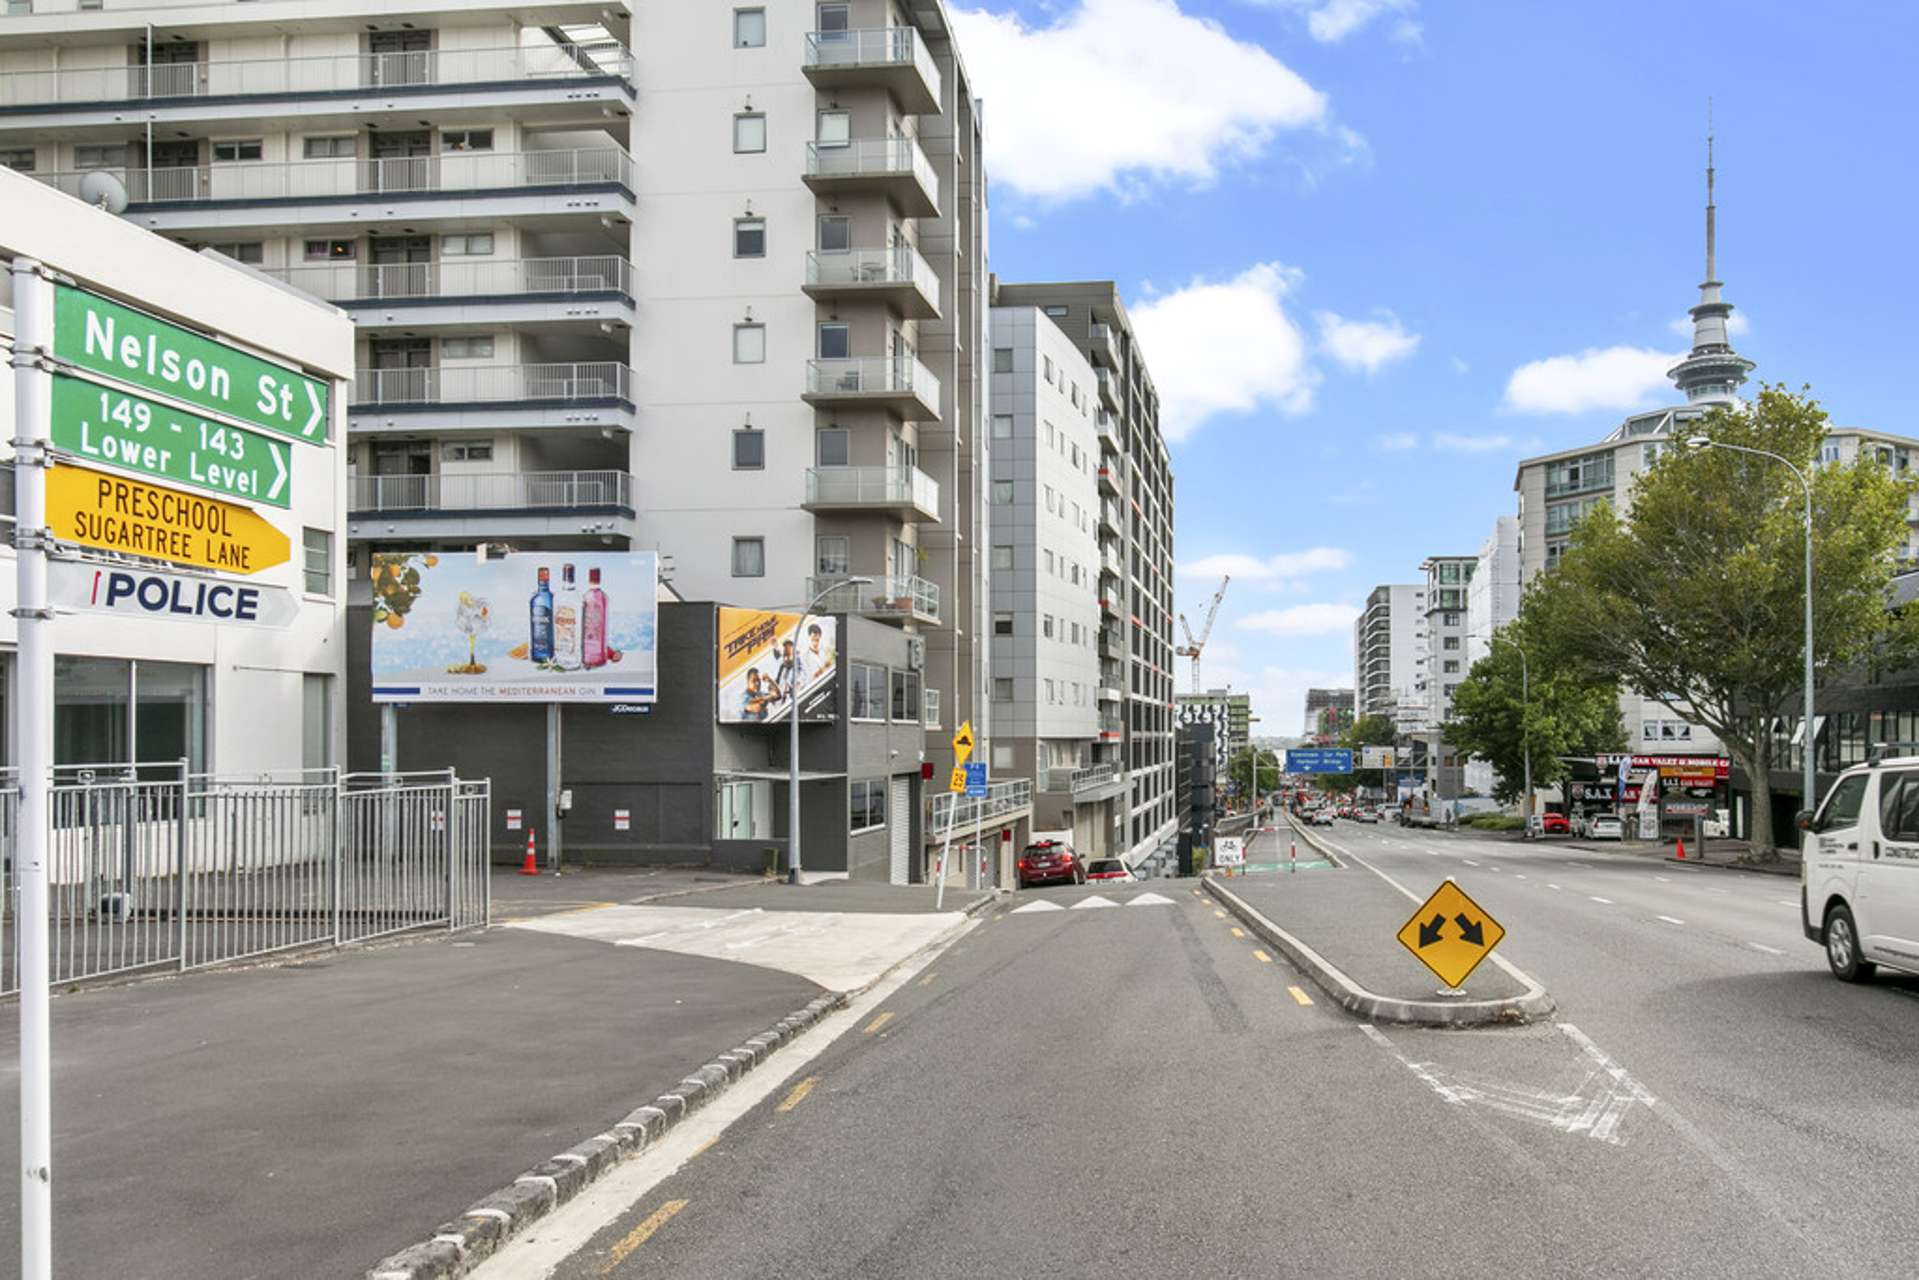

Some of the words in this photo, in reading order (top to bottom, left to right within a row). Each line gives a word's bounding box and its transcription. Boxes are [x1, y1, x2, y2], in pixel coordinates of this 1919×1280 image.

[85, 309, 230, 401] Nelson
[256, 375, 293, 421] St
[100, 392, 151, 432] 149
[200, 422, 244, 460] 143
[80, 422, 171, 472] Lower
[190, 452, 258, 495] Level
[98, 479, 232, 537] PRESCHOOL
[75, 510, 192, 560] SUGARTREE
[207, 538, 250, 570] LANE
[106, 572, 259, 620] POLICE
[428, 687, 449, 696] TAKE
[452, 687, 477, 696] HOME
[481, 687, 496, 696] THE
[499, 686, 576, 696] MEDITERRANEAN
[579, 687, 597, 696] GIN
